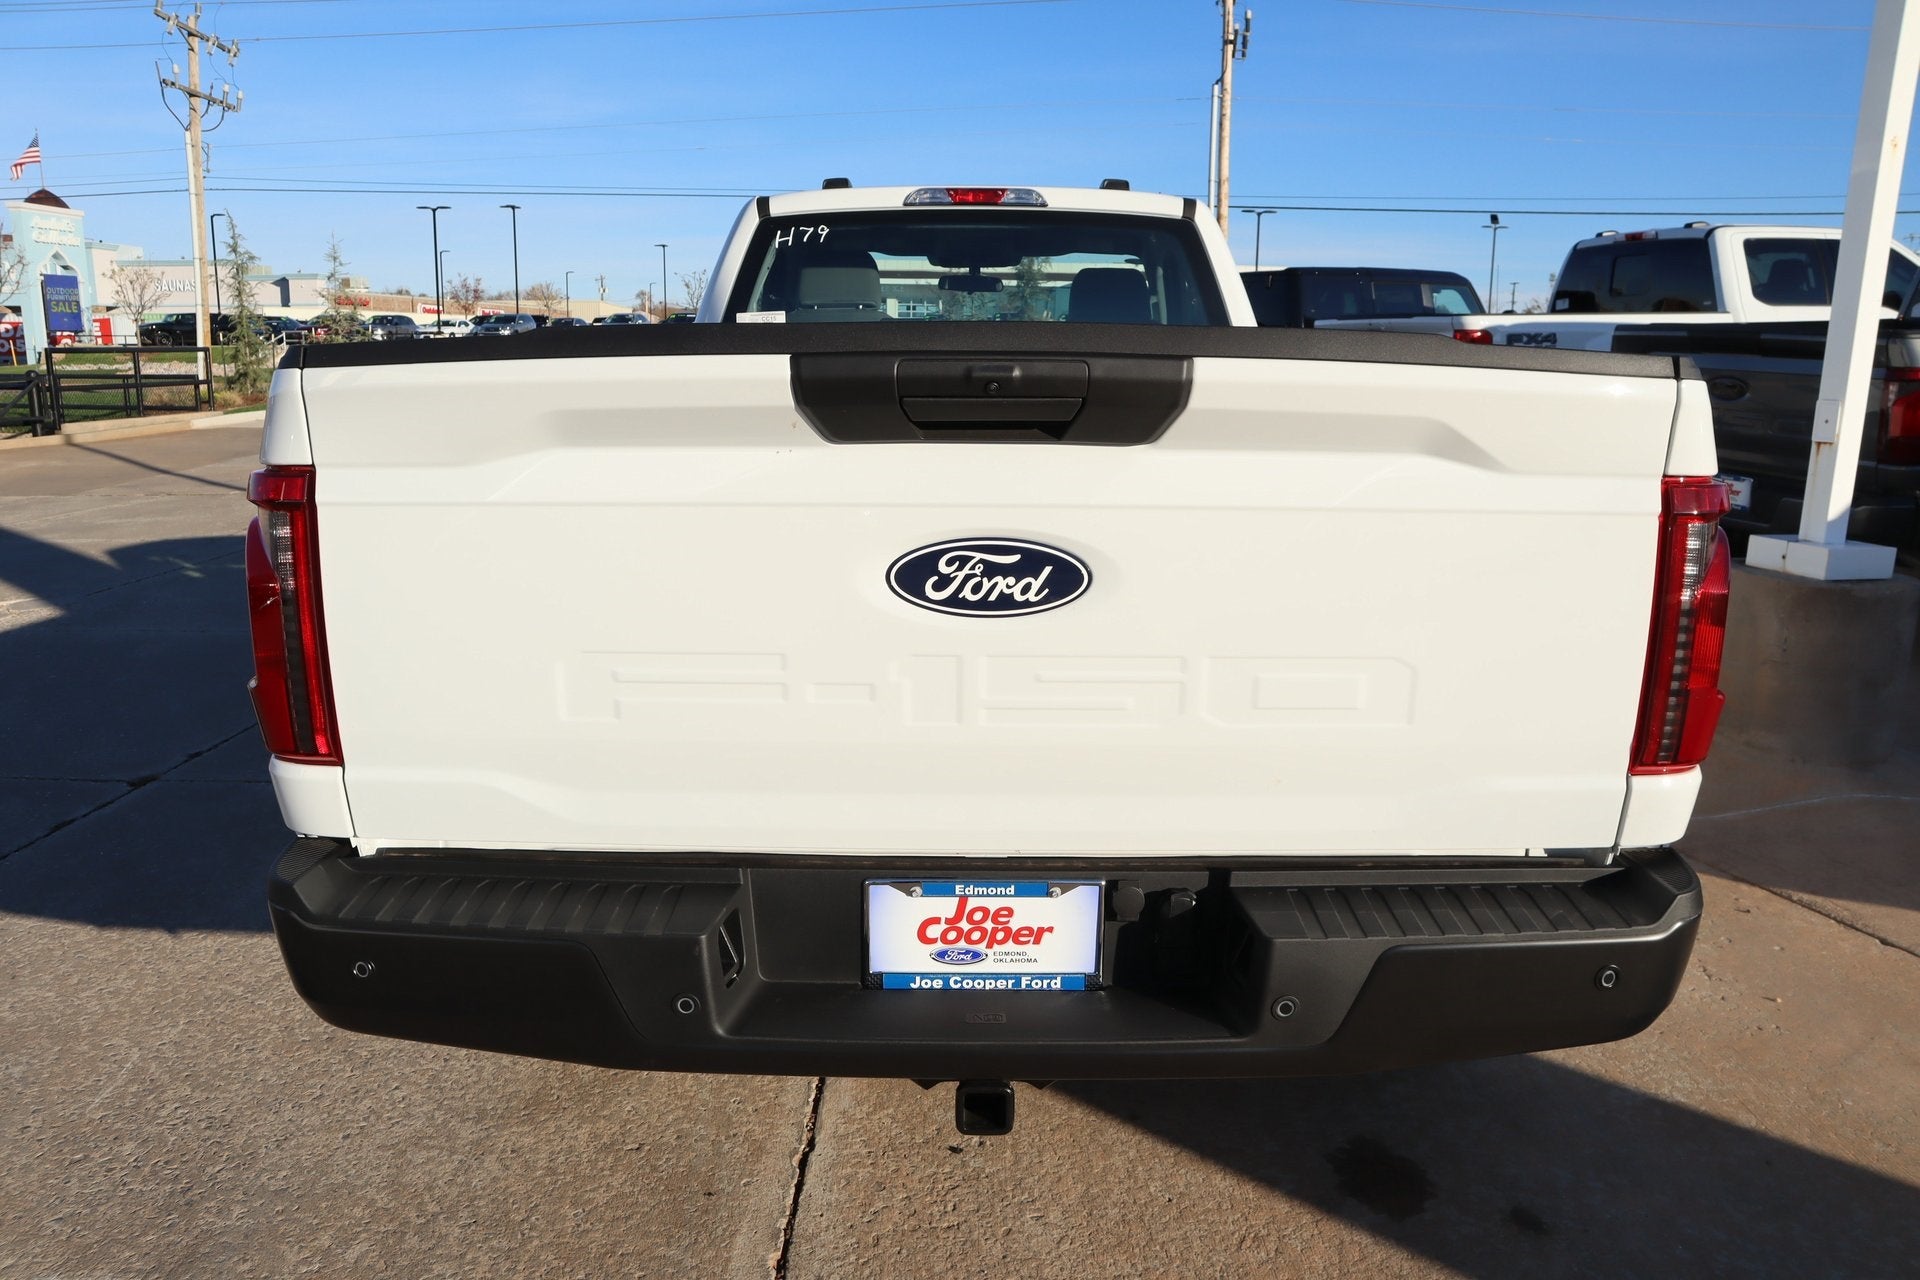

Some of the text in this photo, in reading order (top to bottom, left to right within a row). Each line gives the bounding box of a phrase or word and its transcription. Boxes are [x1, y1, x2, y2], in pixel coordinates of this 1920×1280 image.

[775, 225, 830, 249] H79
[46, 287, 79, 295] OUTDOOR
[154, 279, 196, 292] SAUNAS
[47, 294, 80, 302] FURNITURE
[51, 301, 79, 313] SALE
[1506, 332, 1557, 346] FX4
[925, 551, 1053, 602] Ford
[554, 650, 1417, 727] F-150
[955, 885, 1015, 895] Edmond
[944, 897, 1014, 926] Joe
[917, 917, 1054, 949] Cooper
[944, 948, 973, 962] Ford
[910, 976, 1062, 990] Joe Cooper Ford
